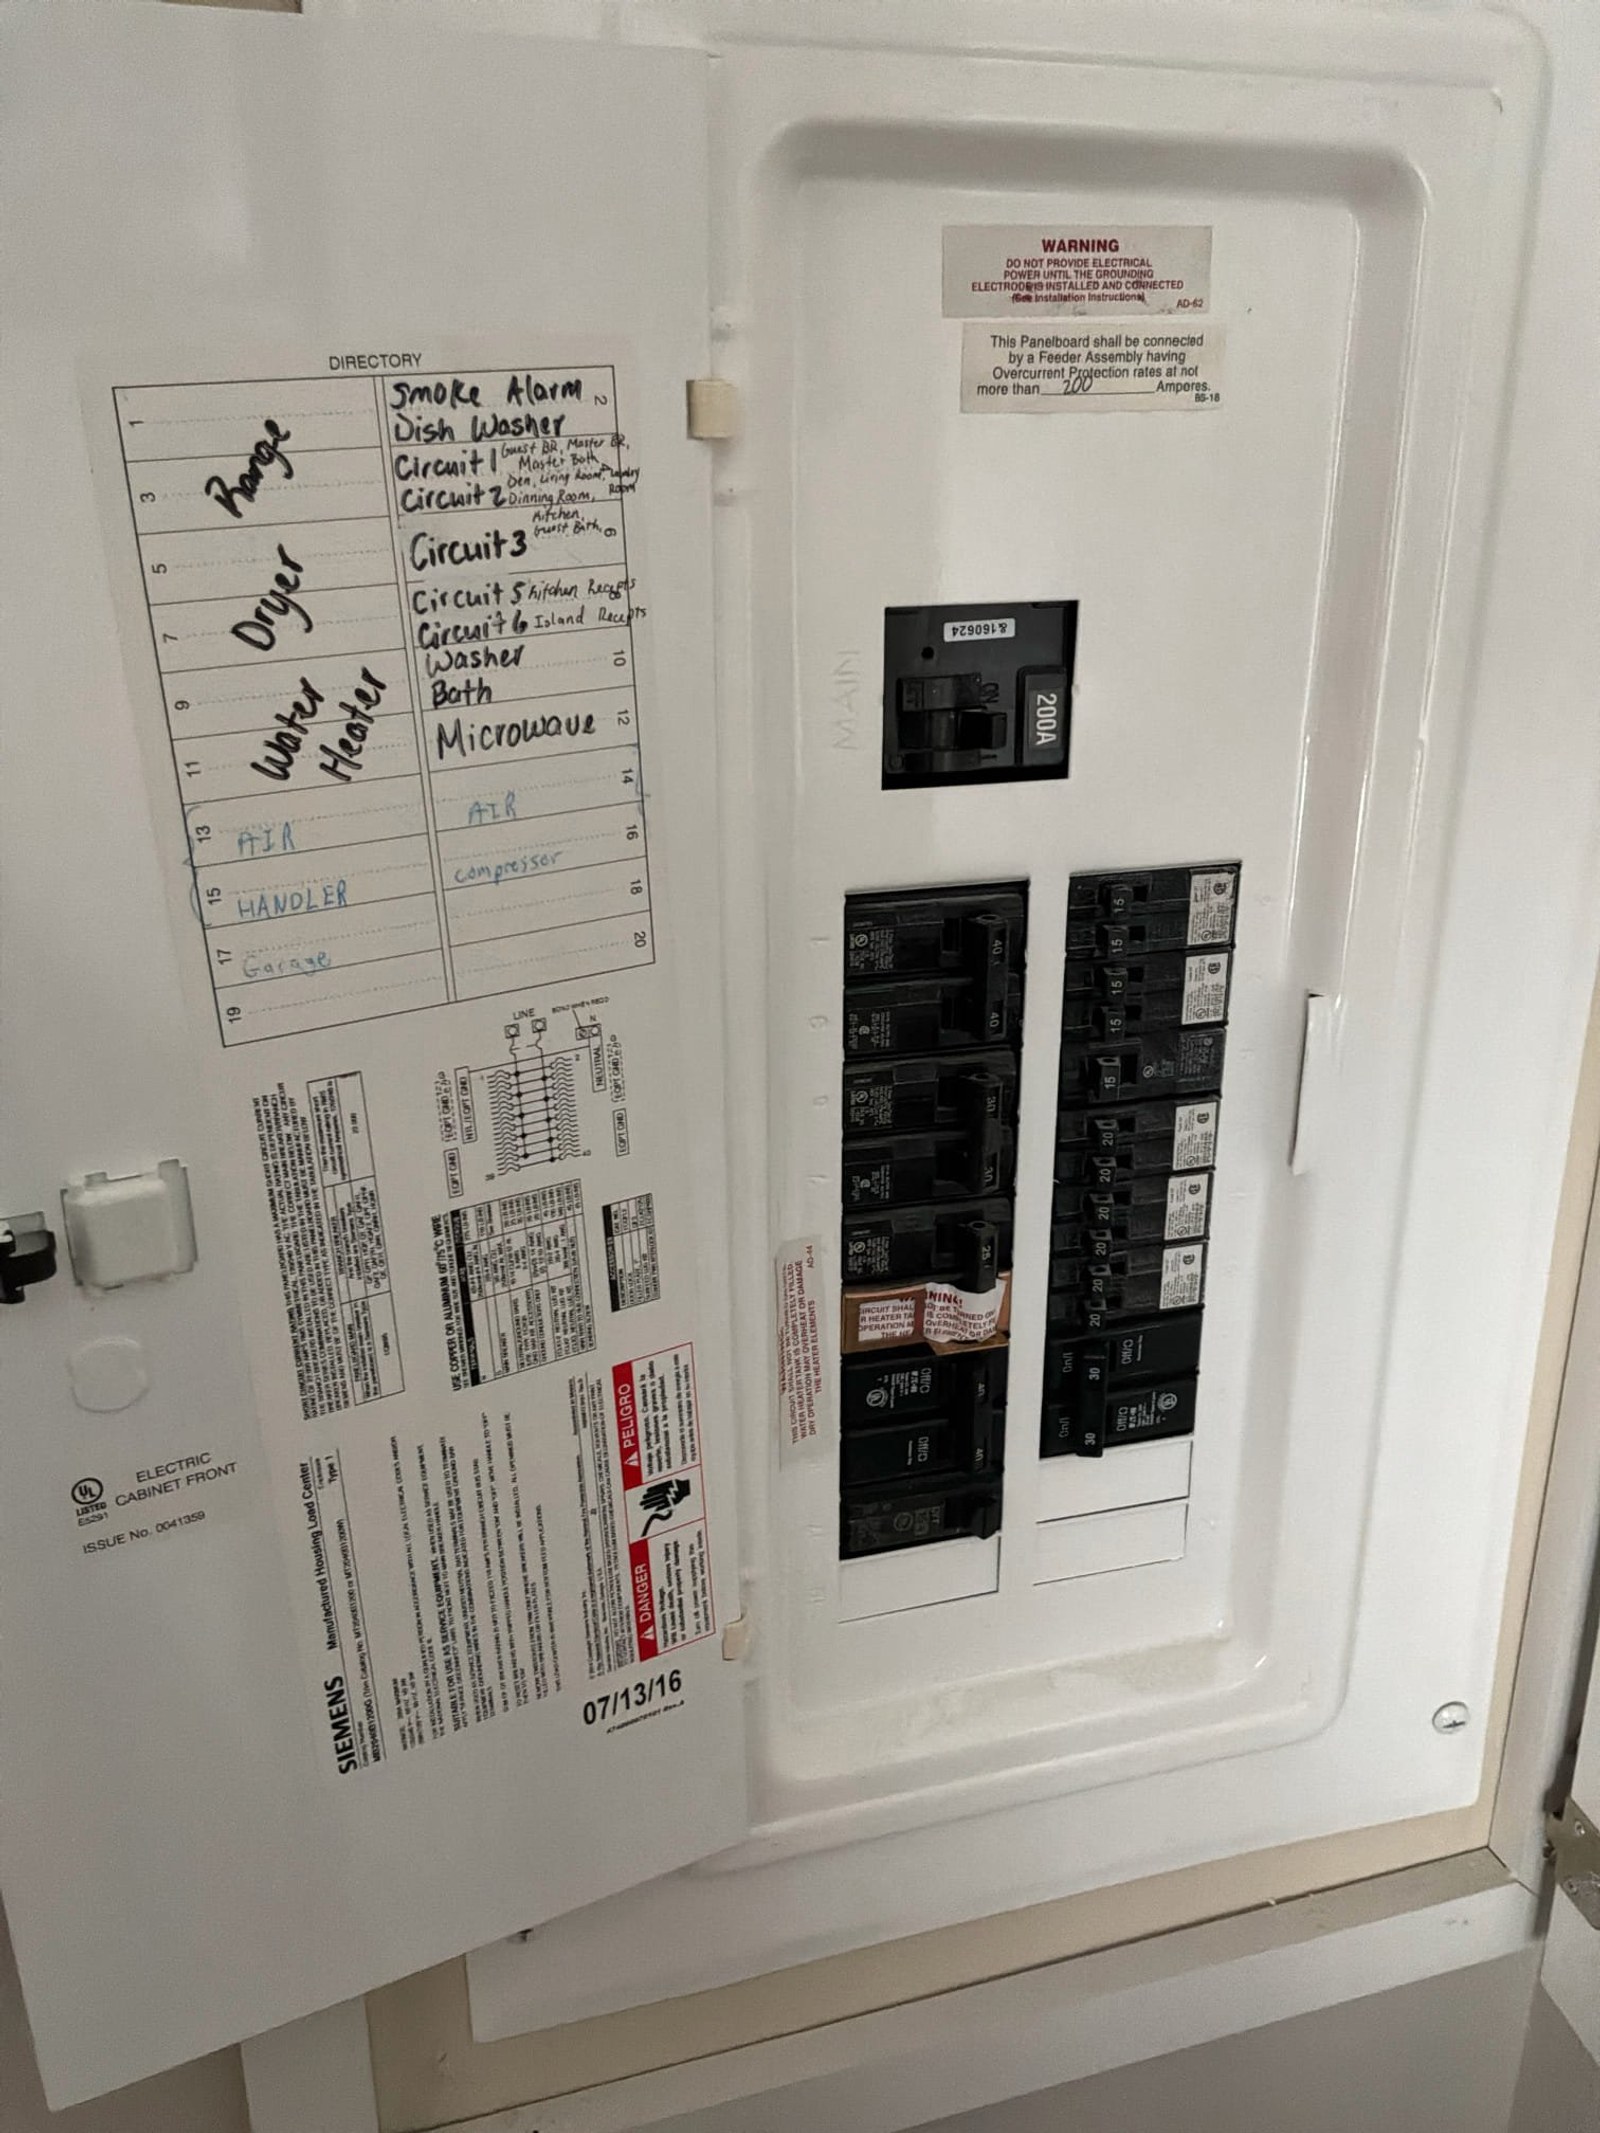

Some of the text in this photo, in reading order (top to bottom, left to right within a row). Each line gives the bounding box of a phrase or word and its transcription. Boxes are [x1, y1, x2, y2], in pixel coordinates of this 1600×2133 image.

[1042, 239, 1119, 253] WARNING
[1006, 258, 1152, 268] DO NOT PROVIDE ELECTRICAL
[1004, 269, 1153, 280] POWER UNTIL THE GROUNDING
[972, 280, 1184, 292] ELECTRODE INSTALLED AND CONNECTED
[1035, 293, 1086, 302] Installation
[991, 334, 1204, 348] This Panelboard shall be connected
[329, 354, 422, 370] DIRECTORY
[1009, 350, 1186, 364] by a Feeder Assembly having
[992, 366, 1198, 379] Overcurrent Protection rates at not
[390, 375, 583, 410] Smoke Alarm
[977, 377, 1211, 395] more than 200 Amperes.
[594, 396, 608, 405] 2
[395, 413, 566, 443] Dish Washer
[501, 443, 536, 458] Guest
[567, 438, 605, 450] Master
[205, 419, 293, 519] Range
[394, 448, 497, 481] Circuit 1
[519, 455, 565, 471] Master
[507, 475, 536, 489] Den,
[540, 471, 570, 486] Living
[140, 492, 156, 502] 3
[400, 482, 507, 512] Circuit 2
[509, 491, 553, 508] Dinning
[534, 523, 568, 537] Guest
[409, 530, 527, 571] Circuit 3
[152, 563, 167, 574] 5
[231, 543, 313, 652] Dryer
[412, 583, 504, 615] Circuit
[510, 581, 526, 604] 5
[528, 580, 578, 601] Kitchen
[418, 611, 506, 650] Circuit
[512, 610, 528, 634] 6
[534, 605, 585, 628] Island
[163, 633, 178, 643] 7
[426, 644, 525, 678] Washer
[613, 650, 627, 667] 10
[431, 677, 493, 710] Bath
[174, 700, 190, 710] 9
[319, 665, 387, 782] Heater
[617, 709, 630, 726] 12
[1036, 693, 1057, 745] 200A
[250, 676, 325, 781] Water
[437, 713, 596, 760] Microwave
[184, 761, 201, 778] 11
[621, 768, 634, 784] 14
[468, 790, 517, 824] AIR
[196, 825, 211, 843] 13
[238, 822, 296, 856] AIR
[626, 824, 639, 840] 16
[454, 851, 563, 885] compressor
[630, 879, 643, 895] 18
[207, 888, 221, 905] 15
[237, 879, 348, 918] HANDLER
[1114, 898, 1124, 912] 15
[634, 931, 647, 948] 20
[992, 939, 1002, 955] 40
[1112, 938, 1123, 952] 15
[216, 949, 231, 965] 17
[242, 951, 331, 978] Garage
[1112, 980, 1122, 994] 15
[227, 1007, 242, 1024] 19
[513, 1008, 536, 1021] LINE
[1110, 1019, 1121, 1032] 15
[1104, 1076, 1116, 1089] 15
[1102, 1132, 1113, 1146] 20
[1100, 1168, 1111, 1182] 20
[1099, 1207, 1110, 1220] 20
[1096, 1242, 1107, 1255] 20
[795, 1260, 804, 1295] DAMAGE
[1092, 1279, 1103, 1292] 20
[798, 1296, 805, 1309] OR
[789, 1293, 798, 1346] COMPLETELY
[808, 1299, 817, 1343] ELEMENTS
[1090, 1313, 1100, 1327] 20
[799, 1310, 809, 1353] OVERHEAT
[811, 1344, 820, 1376] HEATER
[1089, 1367, 1100, 1380] 30
[796, 1378, 804, 1410] HEATER
[804, 1372, 814, 1418] OPERATION
[617, 1381, 636, 1448] PELIGRO
[799, 1410, 807, 1438] WATER
[1085, 1433, 1096, 1445] 30
[136, 1452, 211, 1483] ELECTRIC
[79, 1485, 97, 1499] UL
[115, 1462, 237, 1506] CABINET FRONT
[76, 1502, 107, 1516] LISTED
[83, 1511, 206, 1554] ISSUE No. 0041359
[634, 1562, 651, 1623] DANGER
[297, 1460, 358, 1776] SIEMENS Manufactured Housing Load Center
[583, 1669, 682, 1725] 07/13/16
